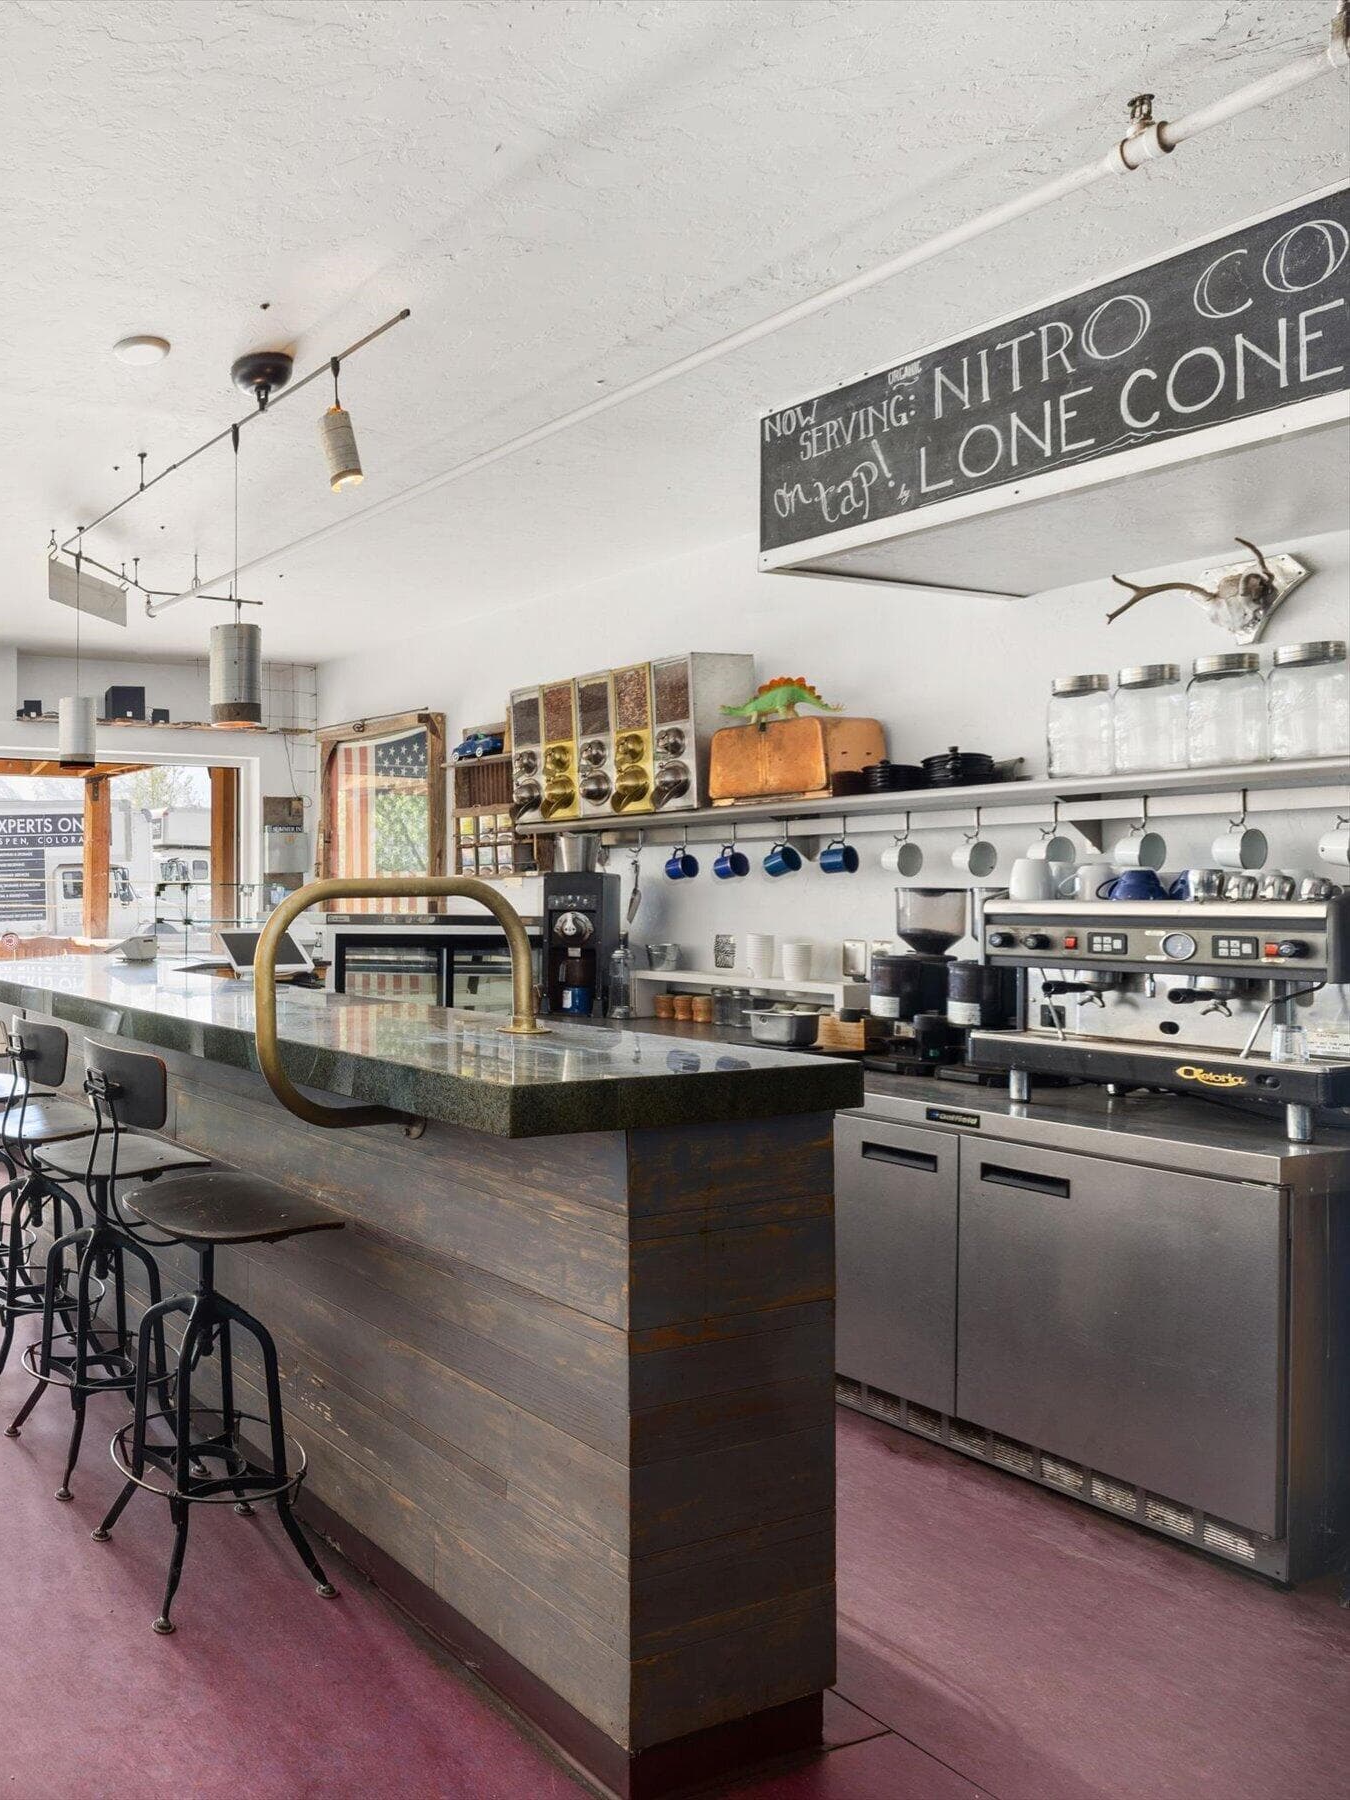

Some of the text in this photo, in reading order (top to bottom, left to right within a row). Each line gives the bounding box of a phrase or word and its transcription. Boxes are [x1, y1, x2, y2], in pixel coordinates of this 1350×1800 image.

[934, 218, 1349, 420] NITRO CO
[887, 360, 922, 386] ORGANIC
[763, 399, 819, 442] NOW
[799, 394, 916, 461] SERVING:
[897, 298, 1345, 506] by LONE CONE
[774, 439, 895, 523] on tap!
[37, 836, 84, 845] COLORA
[57, 817, 84, 832] ON
